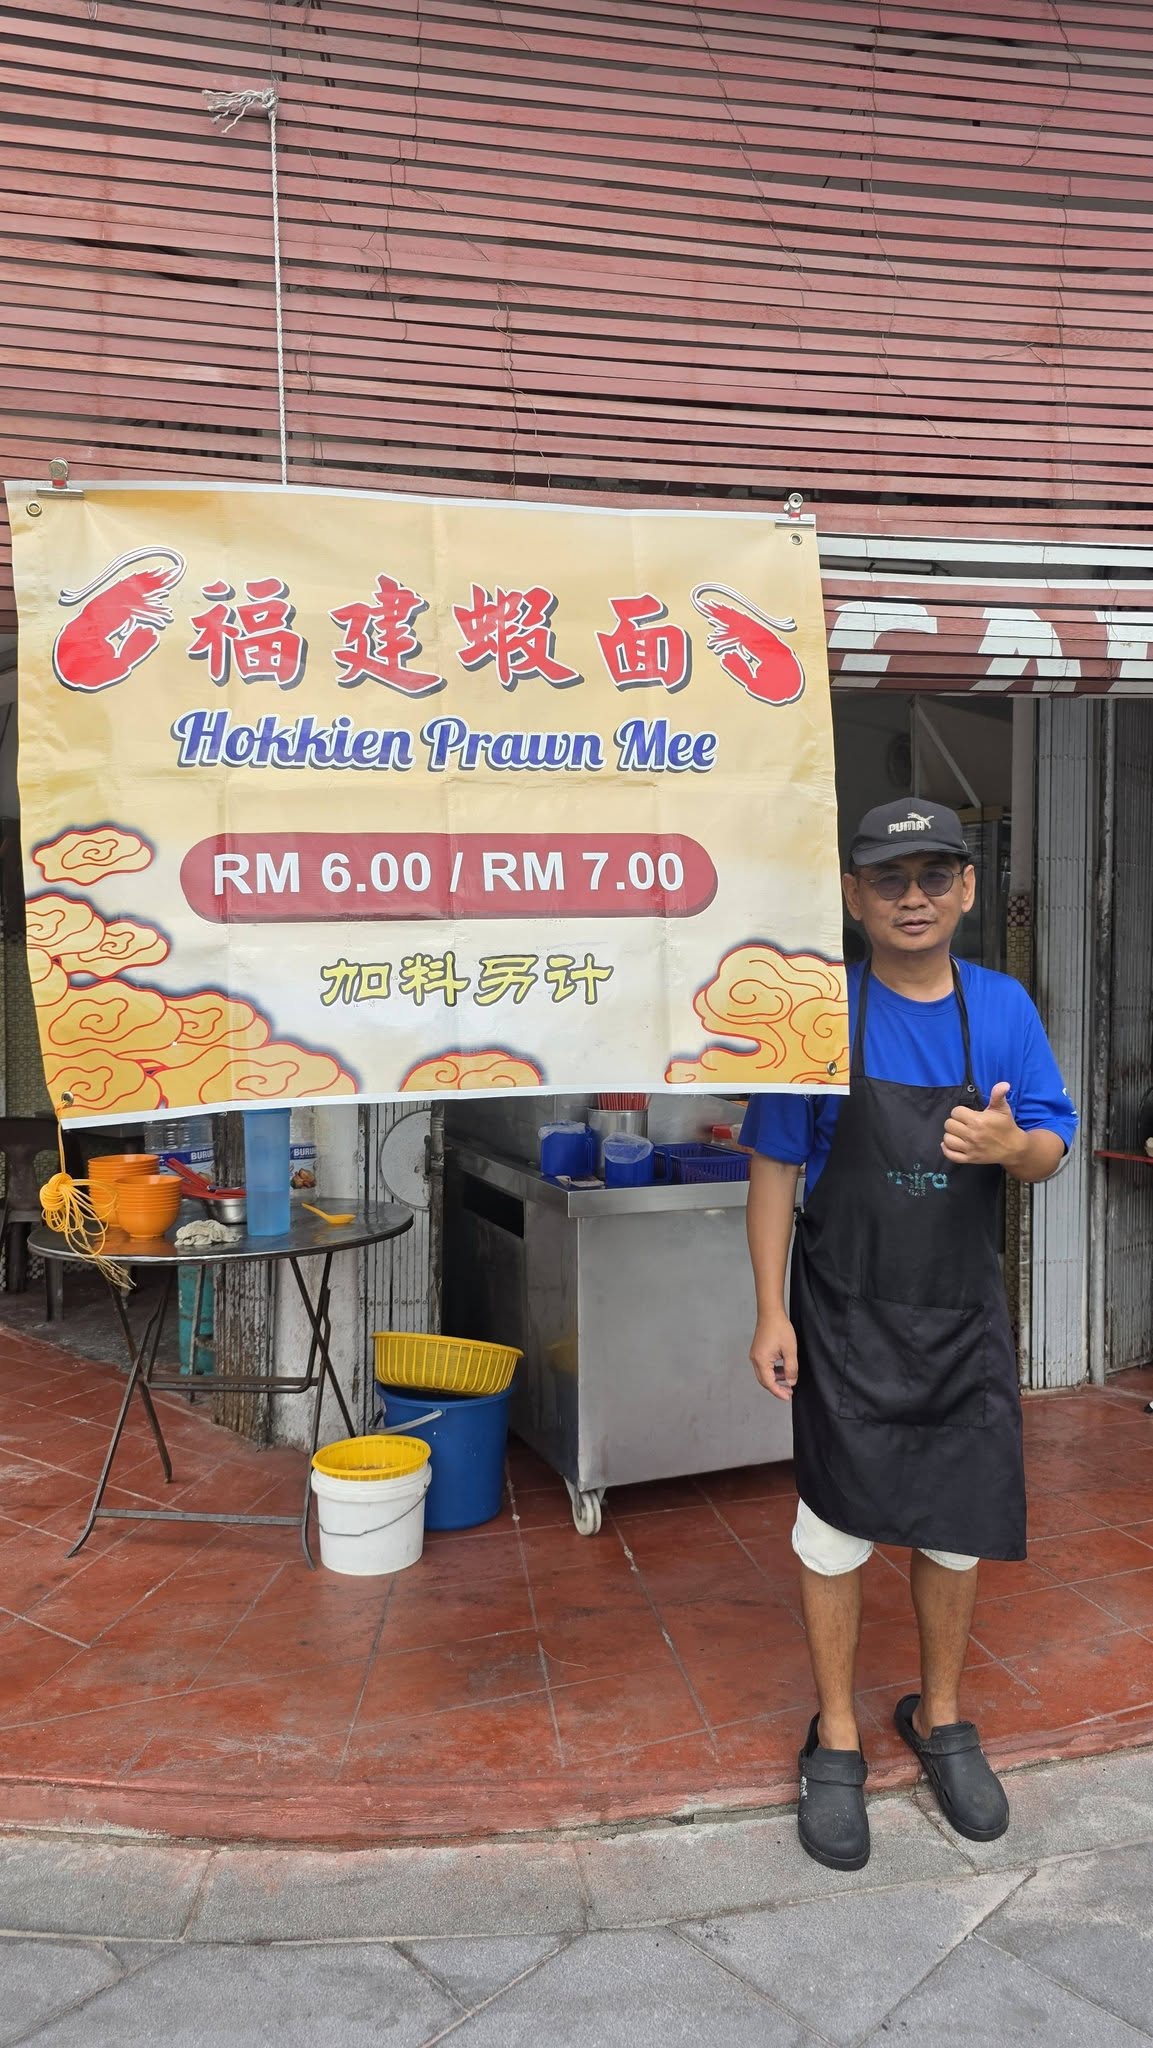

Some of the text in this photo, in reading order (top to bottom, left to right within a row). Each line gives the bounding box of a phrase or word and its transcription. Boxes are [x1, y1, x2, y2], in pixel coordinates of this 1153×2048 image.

[189, 574, 692, 696] 福建蝦面
[173, 709, 718, 771] Hokkien Prawn Mee
[888, 820, 925, 834] PUMA
[213, 851, 300, 896] RM
[321, 852, 431, 893] 6.00
[482, 852, 565, 892] RM
[582, 851, 685, 891] 7.00
[320, 951, 614, 1007] 加料另计
